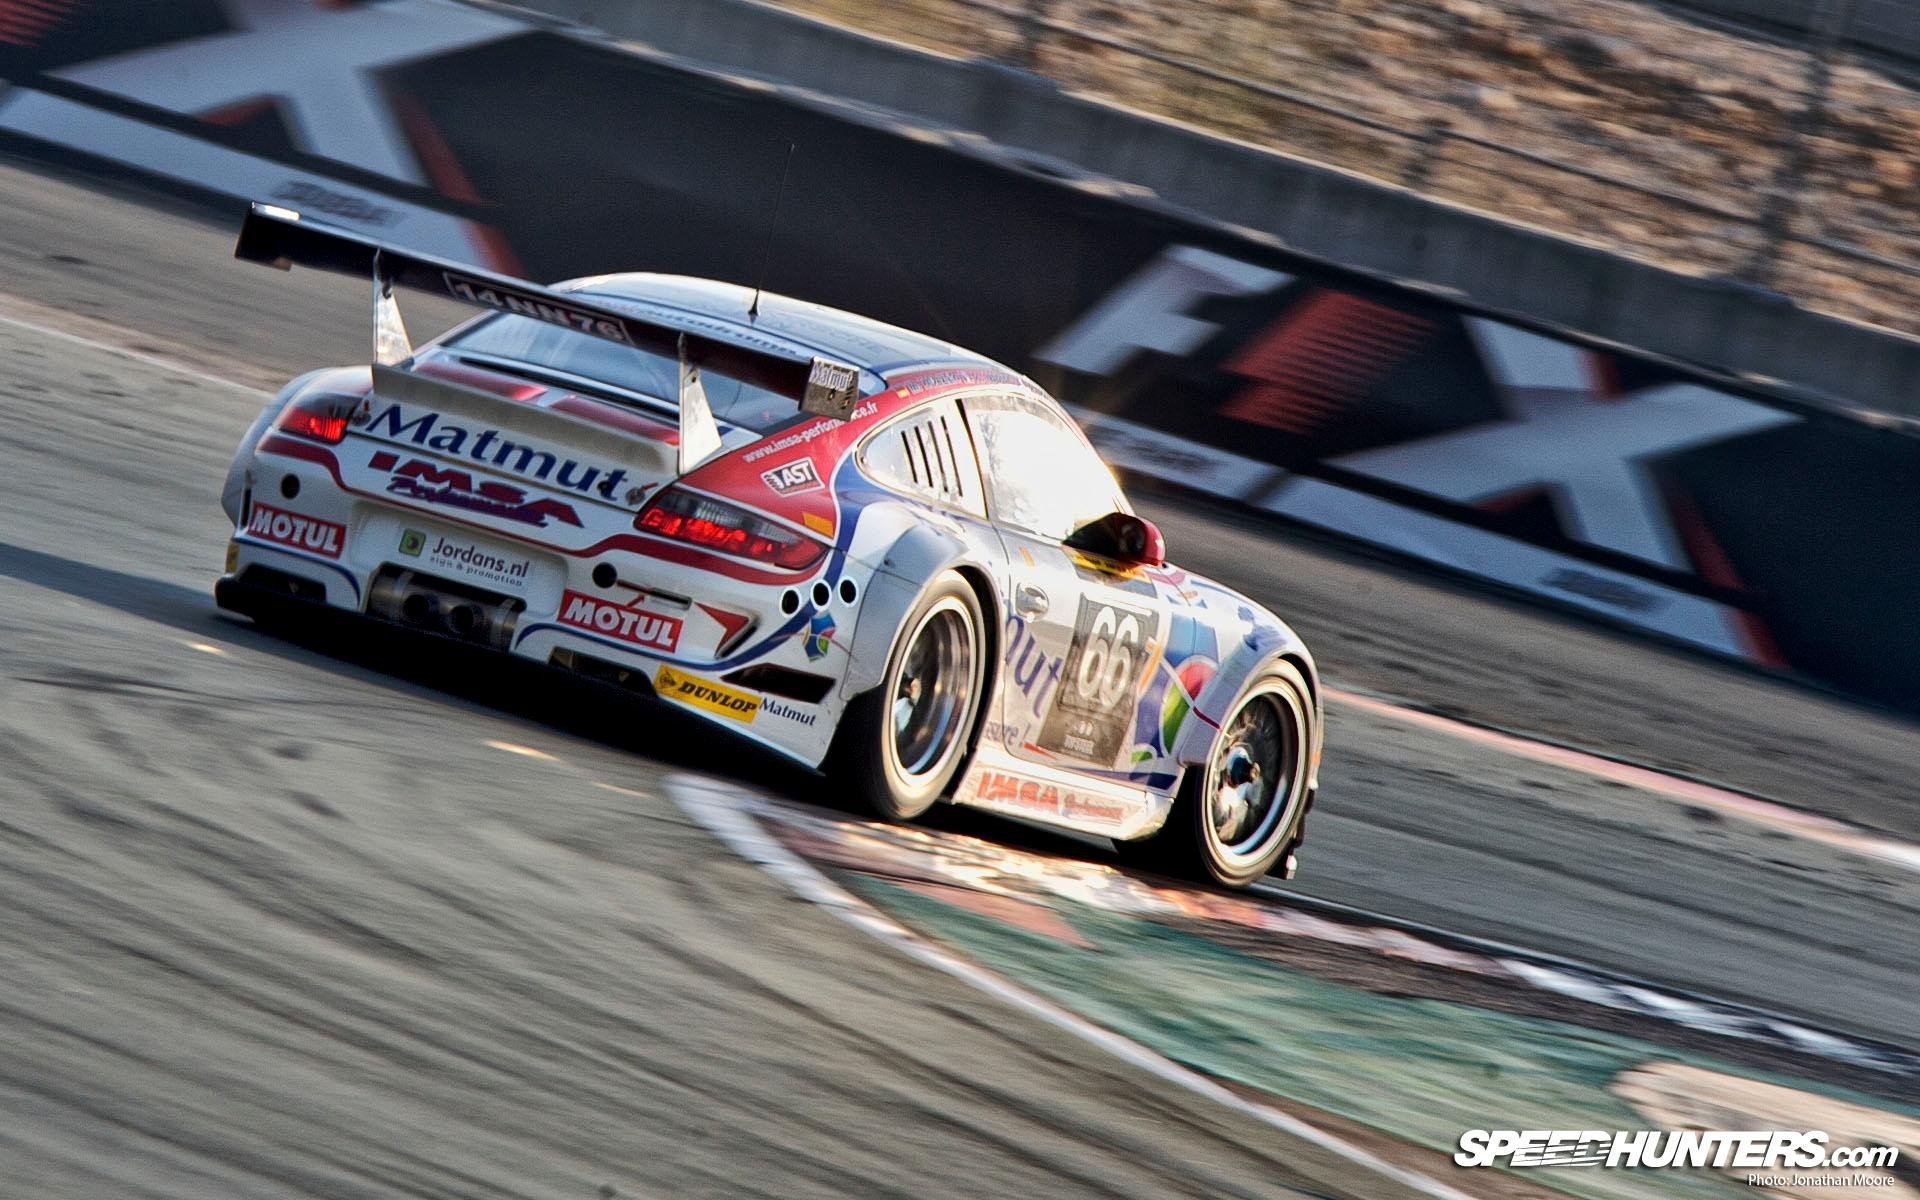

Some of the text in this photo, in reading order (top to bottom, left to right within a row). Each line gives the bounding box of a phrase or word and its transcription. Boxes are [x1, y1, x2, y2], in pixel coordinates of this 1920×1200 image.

[366, 404, 629, 502] Matmut
[743, 401, 879, 463] www.imsa-performnce.fr
[368, 451, 585, 528] IMSA
[781, 461, 812, 486] AST
[250, 507, 338, 552] MOTUL
[432, 536, 530, 578] Jordans.nl
[466, 566, 522, 587] promotion
[562, 598, 675, 648] MOTUL
[1078, 605, 1140, 709] 66
[678, 681, 758, 713] DUNLOP
[759, 697, 817, 726] Matmut
[976, 771, 1060, 813] IMSA
